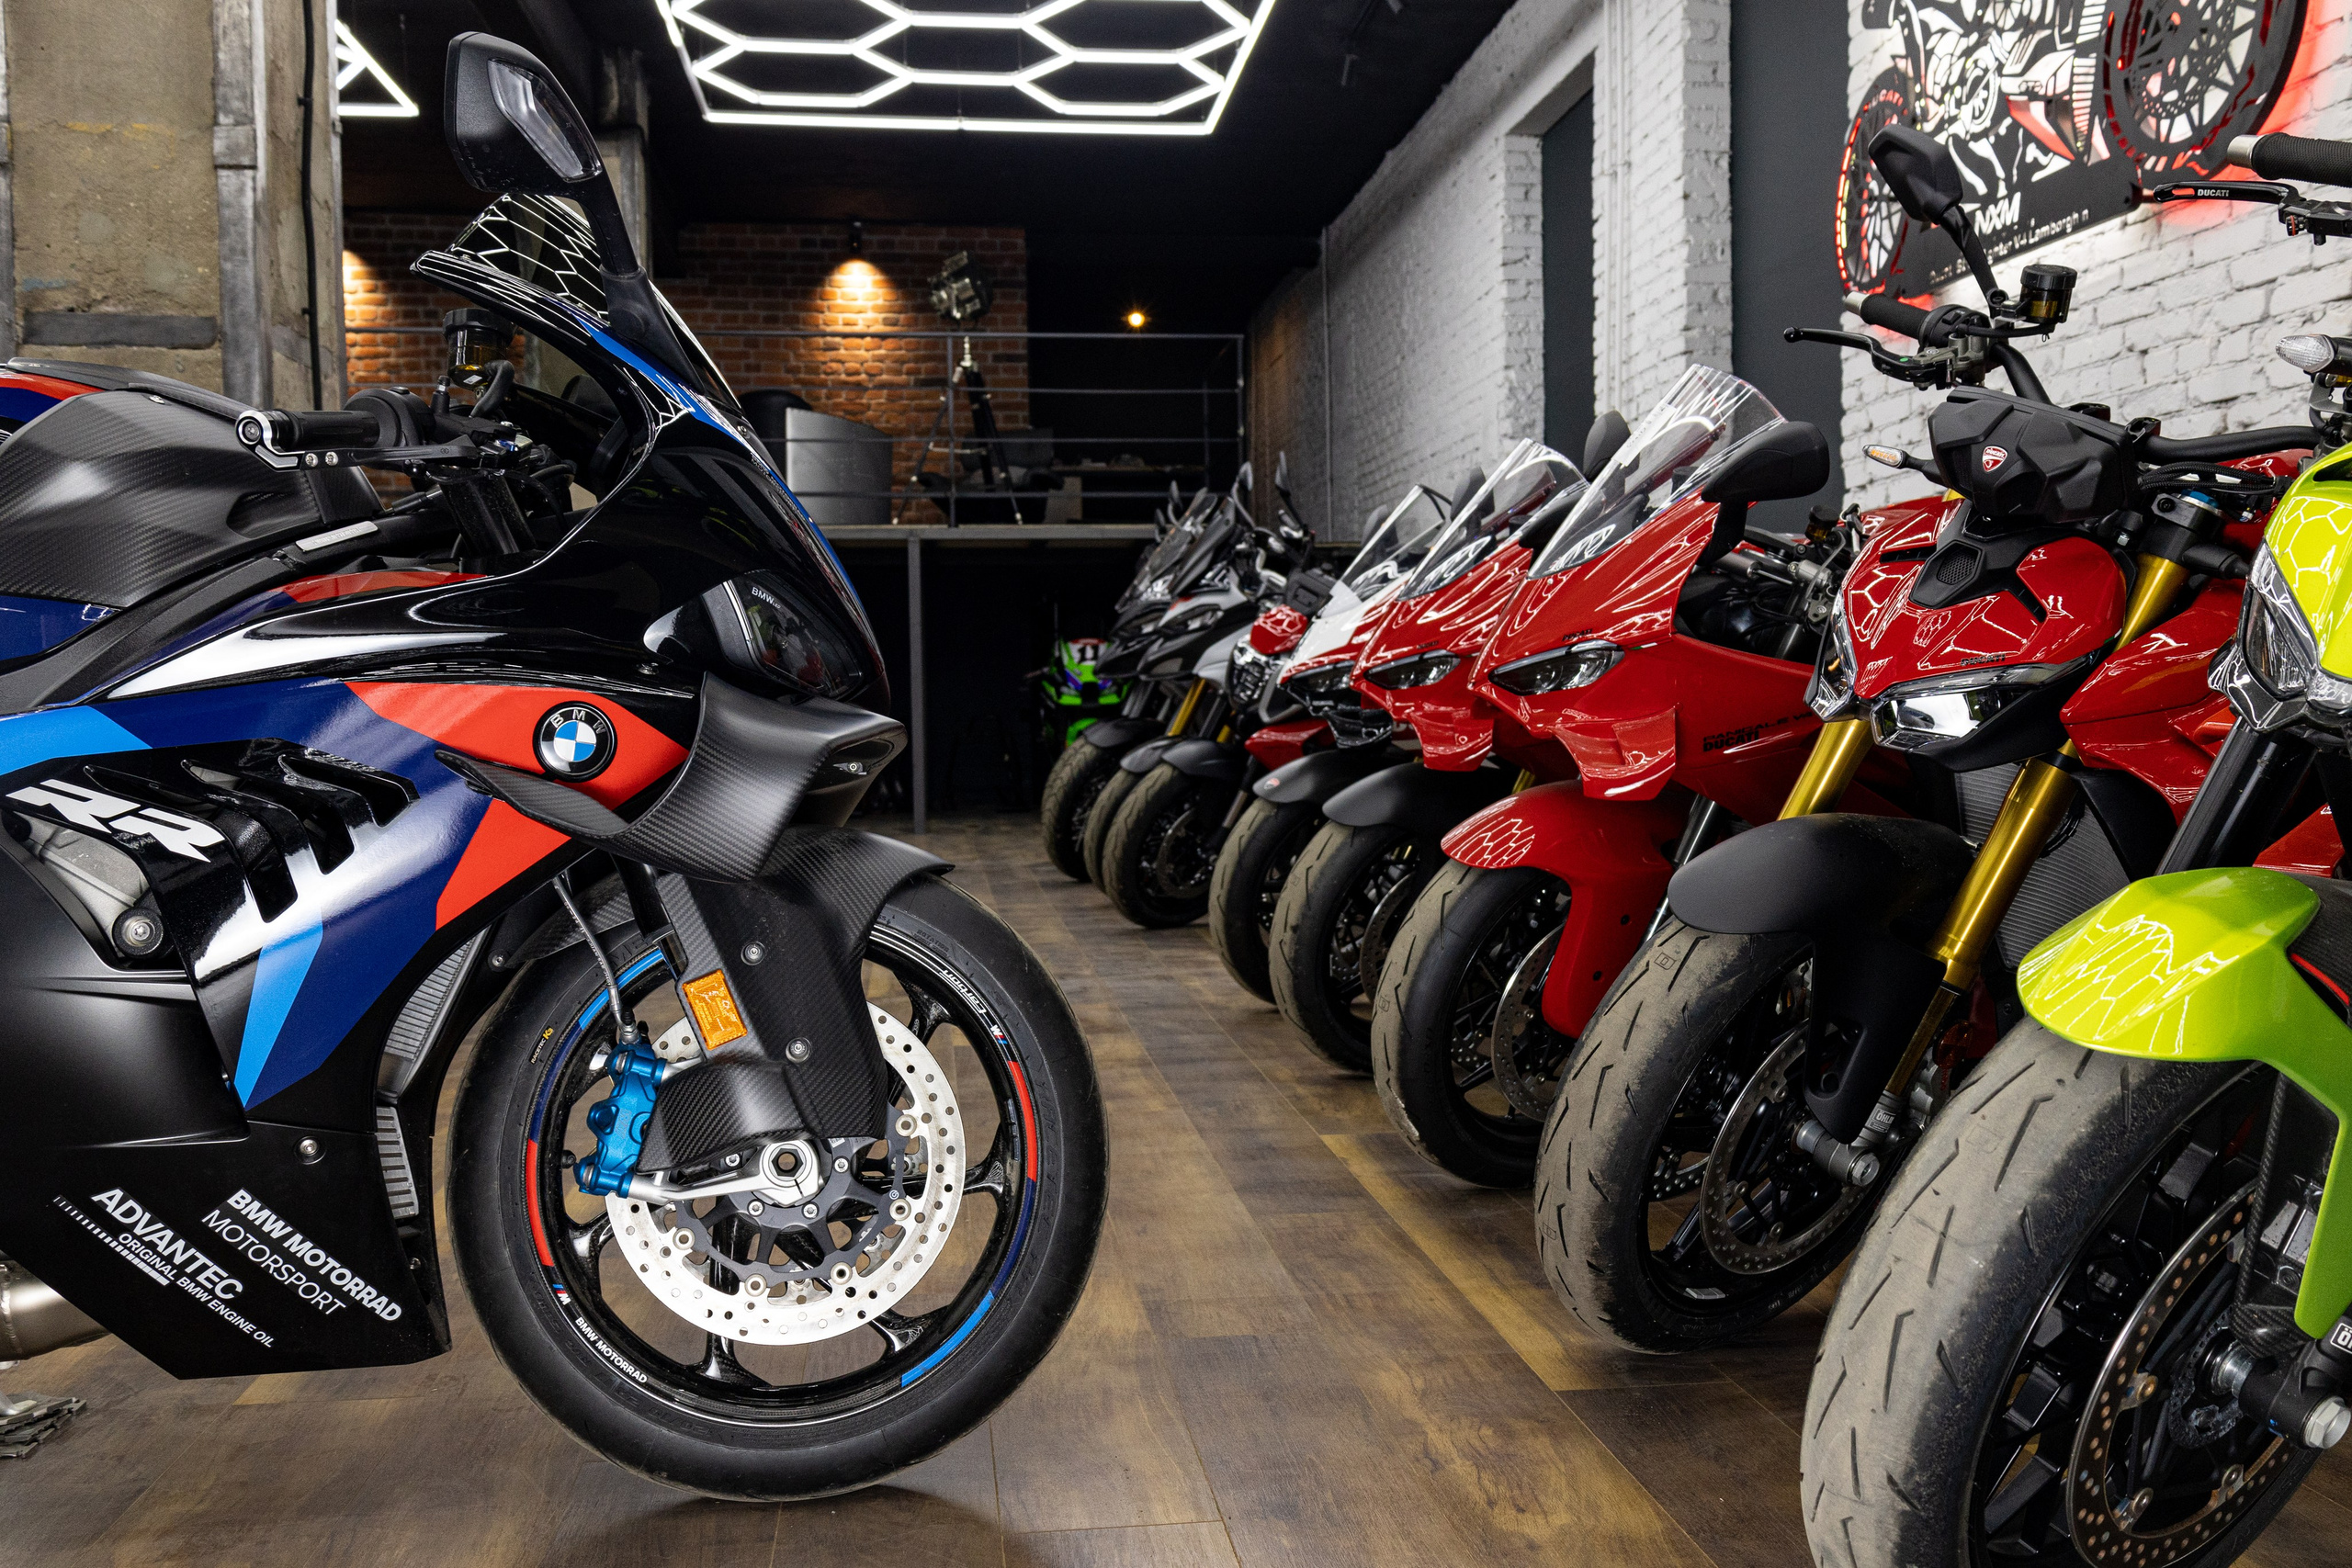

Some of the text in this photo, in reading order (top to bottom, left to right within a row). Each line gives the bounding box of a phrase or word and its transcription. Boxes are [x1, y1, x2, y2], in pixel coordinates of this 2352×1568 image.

[1974, 191, 2021, 237] NXM
[2197, 188, 2230, 197] DUCATI
[752, 587, 775, 604] BMW
[550, 708, 606, 735] BMW
[1702, 716, 1790, 742] PANIGALE
[1702, 730, 1760, 752] DUCATI
[6, 779, 226, 863] RR
[530, 1038, 546, 1064] RACETEC
[91, 1188, 243, 1300] ADVANTEC
[202, 1209, 346, 1315] MOTORSPORT
[227, 1189, 401, 1322] BMW MOTORRAD
[119, 1232, 274, 1348] ORIGINAL BMW ENGINE OIL
[575, 1316, 648, 1383] BMW MOTORRAD
